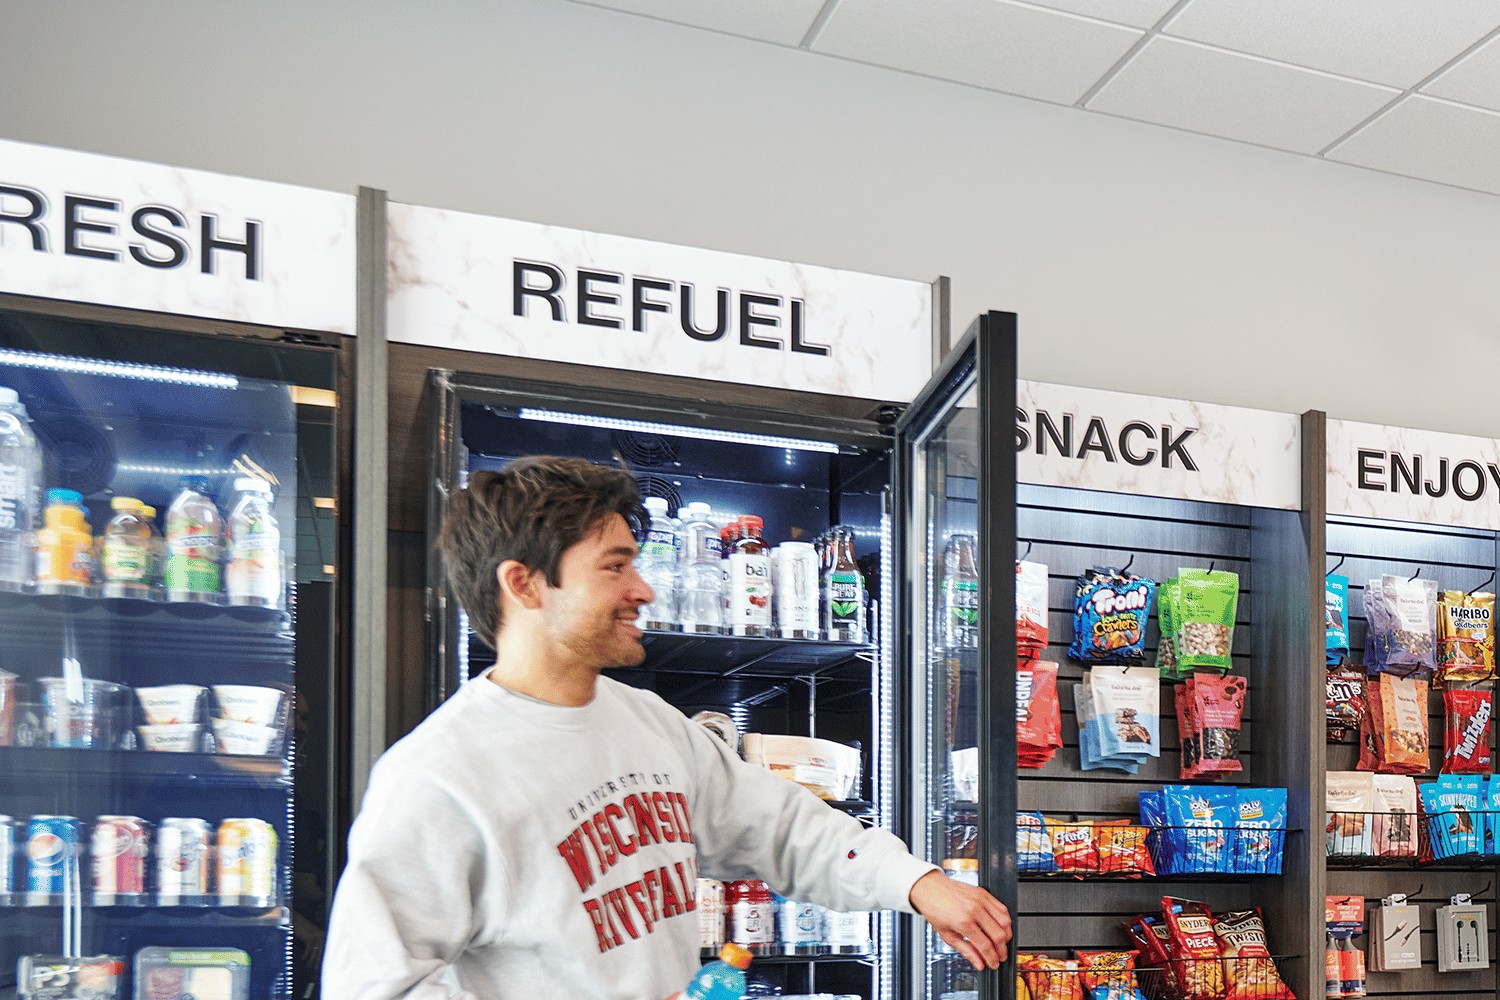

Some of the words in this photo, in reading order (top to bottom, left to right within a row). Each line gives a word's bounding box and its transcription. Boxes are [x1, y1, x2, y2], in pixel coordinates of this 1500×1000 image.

[512, 258, 832, 357] REFUEL
[745, 562, 768, 577] bai
[833, 583, 856, 592] PURE
[1092, 585, 1148, 614] Trolli
[1450, 606, 1491, 620] HARIBO
[1094, 620, 1138, 636] Crawlers
[1239, 800, 1261, 811] JOLLY
[1184, 819, 1224, 829] ZERO
[1235, 820, 1271, 830] ZERO
[1187, 829, 1224, 838] SUGAR
